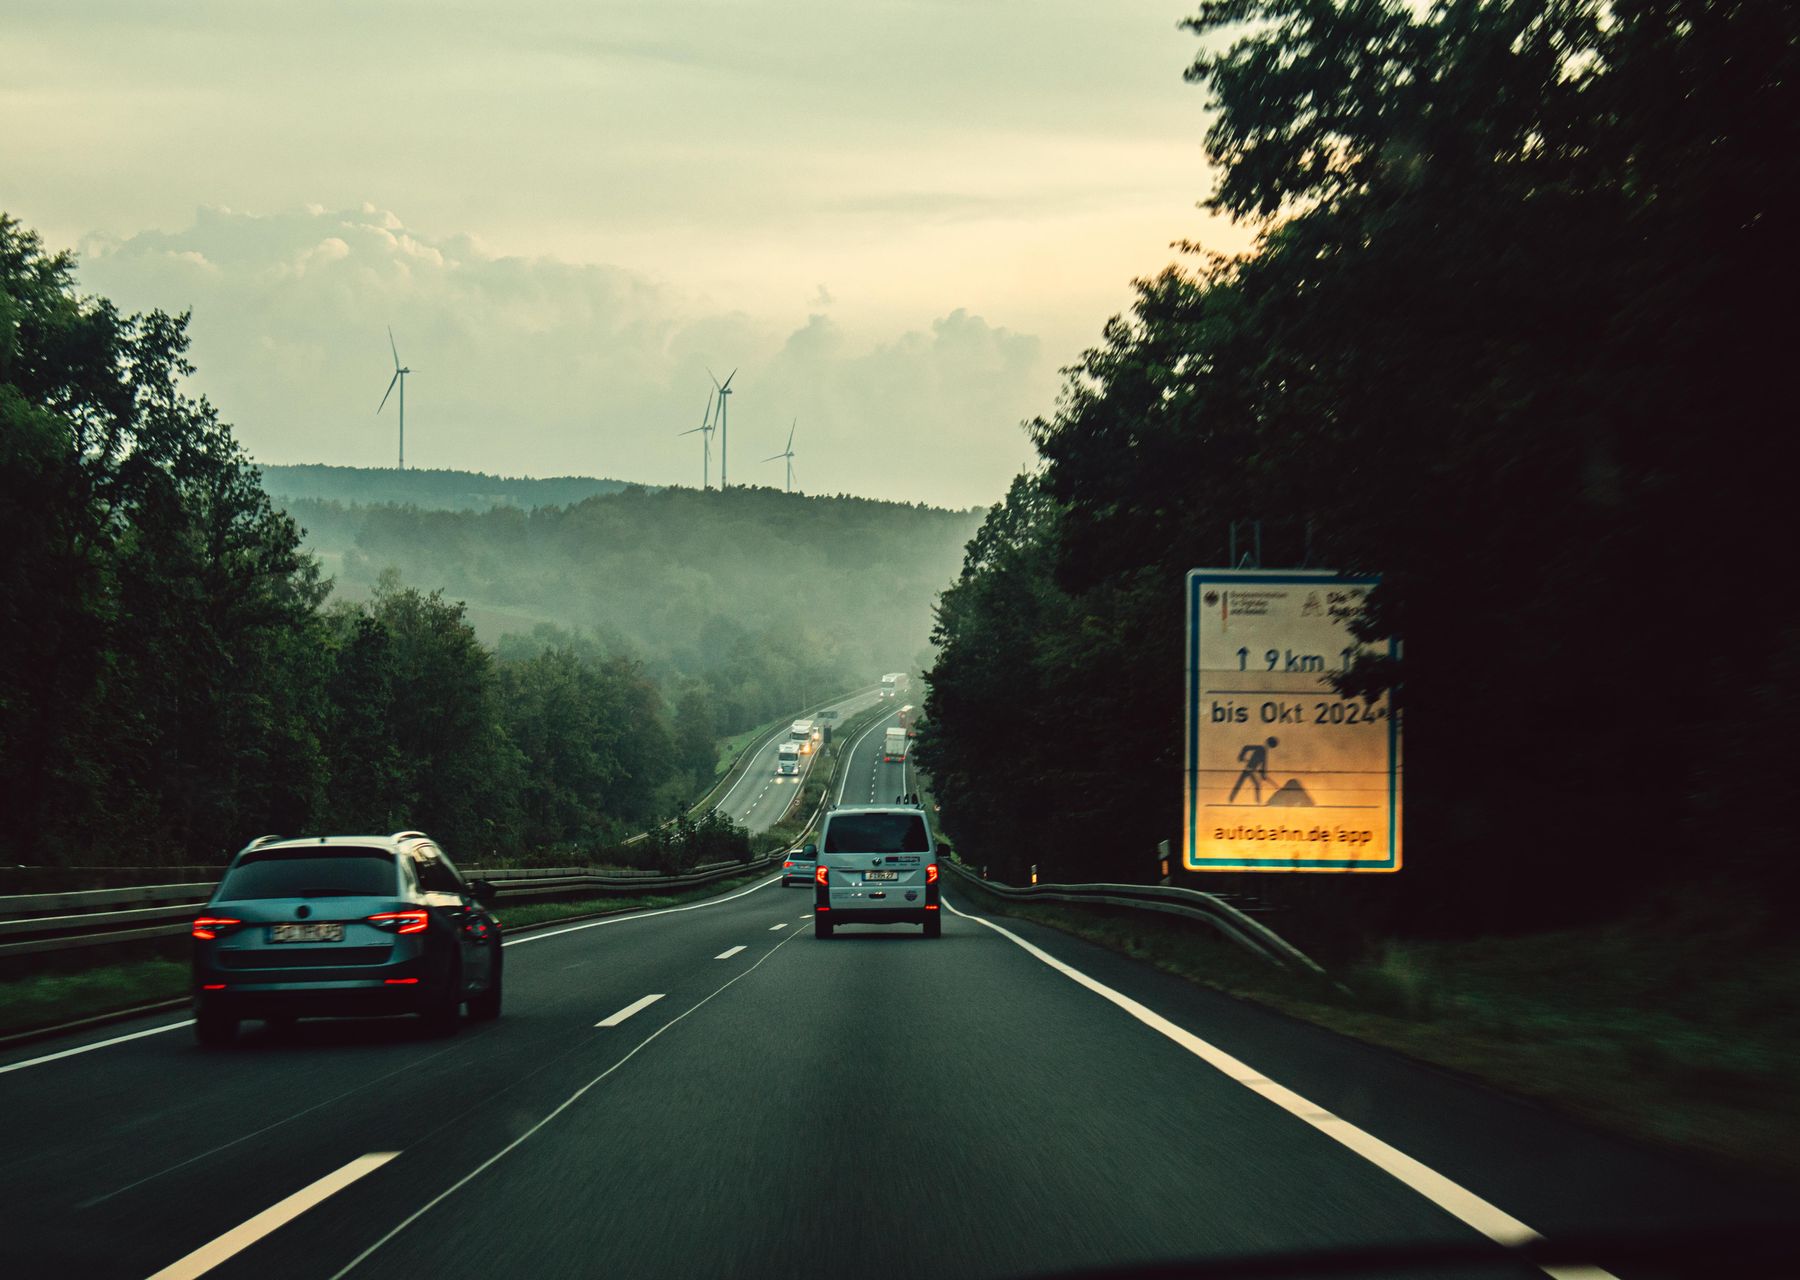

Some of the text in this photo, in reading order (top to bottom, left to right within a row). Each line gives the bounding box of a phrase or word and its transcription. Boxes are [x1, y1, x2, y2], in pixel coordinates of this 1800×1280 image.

[1264, 649, 1326, 672] 9 km
[1212, 702, 1377, 725] bis Okt 2024
